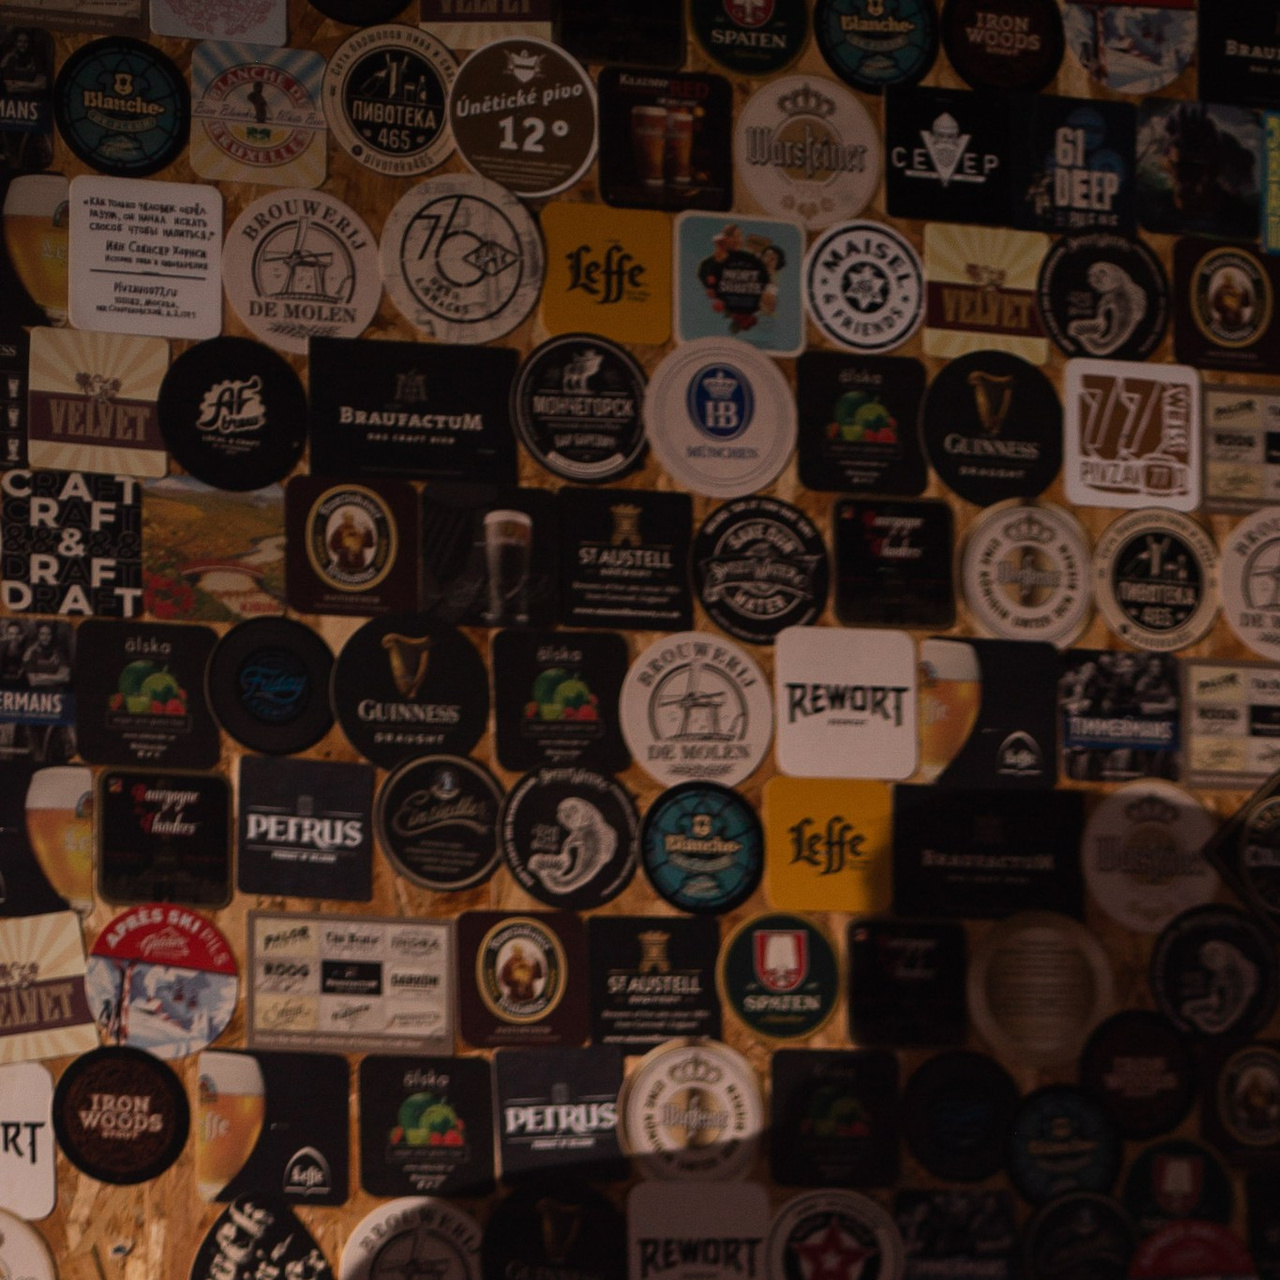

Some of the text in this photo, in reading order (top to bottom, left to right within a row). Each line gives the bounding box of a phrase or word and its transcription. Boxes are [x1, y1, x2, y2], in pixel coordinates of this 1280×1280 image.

[976, 11, 1030, 31] IRON
[710, 28, 788, 49] SPATEN
[965, 27, 1042, 50] WOODS
[83, 89, 166, 116] Blanche
[352, 100, 438, 130] ПИВОТЕКА
[456, 82, 585, 118] Únětické pivo
[377, 127, 412, 150] 465
[1055, 125, 1087, 168] 61
[1054, 167, 1120, 211] DEEP
[241, 199, 368, 252] BROUWERIJ
[564, 243, 646, 305] Leffe
[822, 238, 912, 283] MAISEL
[249, 302, 357, 323] DE MOLEN
[832, 307, 904, 337] FRIENDS
[49, 399, 151, 443] VELVET
[338, 405, 484, 433] BRAUFACTUM
[704, 401, 739, 429] HB
[599, 548, 675, 570] AUSTELL
[356, 697, 462, 725] GUINNESS
[783, 681, 911, 727] REWORT
[246, 812, 365, 848] PETRUS
[788, 814, 867, 876] Leffe
[105, 907, 164, 950] APRÈS
[166, 909, 201, 935] SKI
[89, 1092, 151, 1113] IRON
[78, 1109, 164, 1133] WOODS
[503, 1102, 618, 1136] PETRUS
[637, 1236, 763, 1280] REWORT
